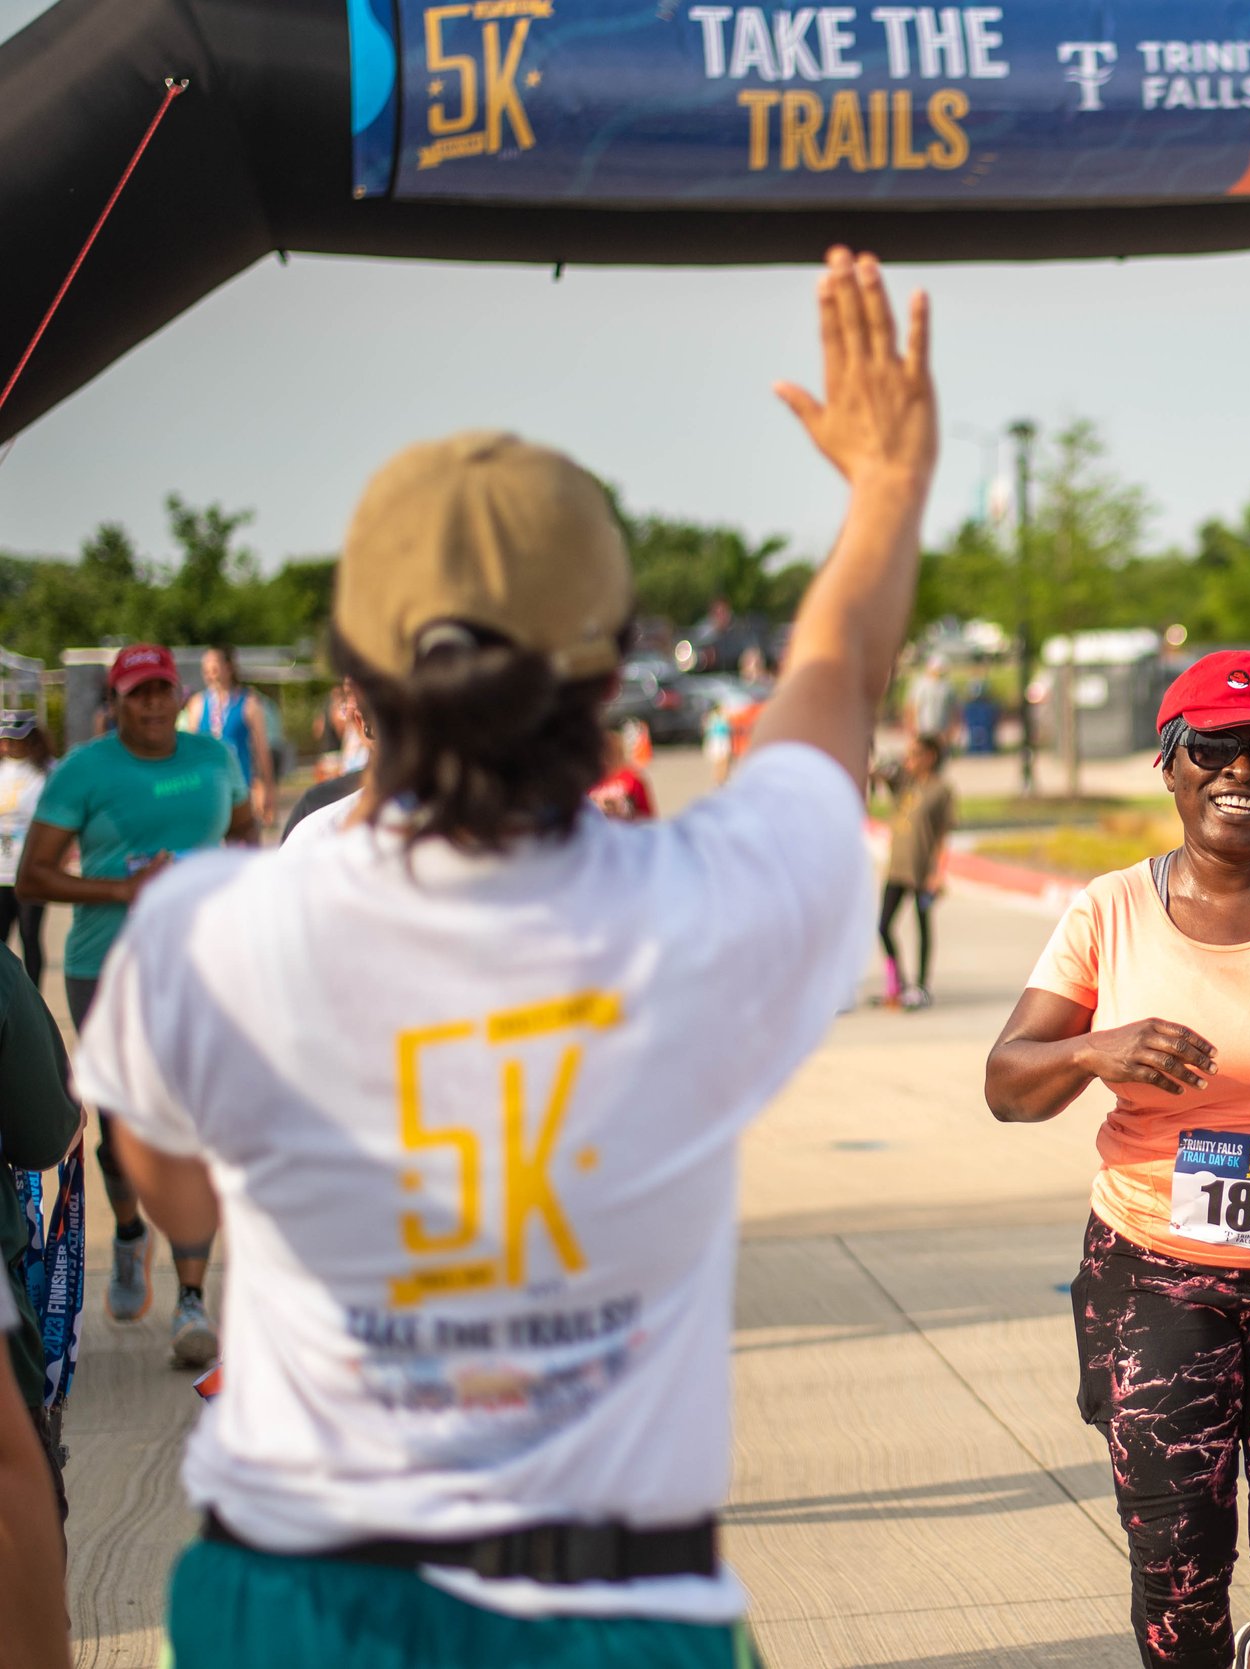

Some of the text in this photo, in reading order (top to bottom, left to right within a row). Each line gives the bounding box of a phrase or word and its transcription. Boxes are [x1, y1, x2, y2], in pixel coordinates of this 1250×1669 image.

[424, 5, 537, 154] 5K
[688, 6, 1010, 81] TAKE THE
[737, 88, 970, 172] TRAILS
[398, 1020, 588, 1290] 5K
[1182, 1138, 1243, 1156] TRINITY FALLS
[1182, 1150, 1240, 1168] TRAIL DAY 5K
[42, 1245, 67, 1357] 2023 FINISHER
